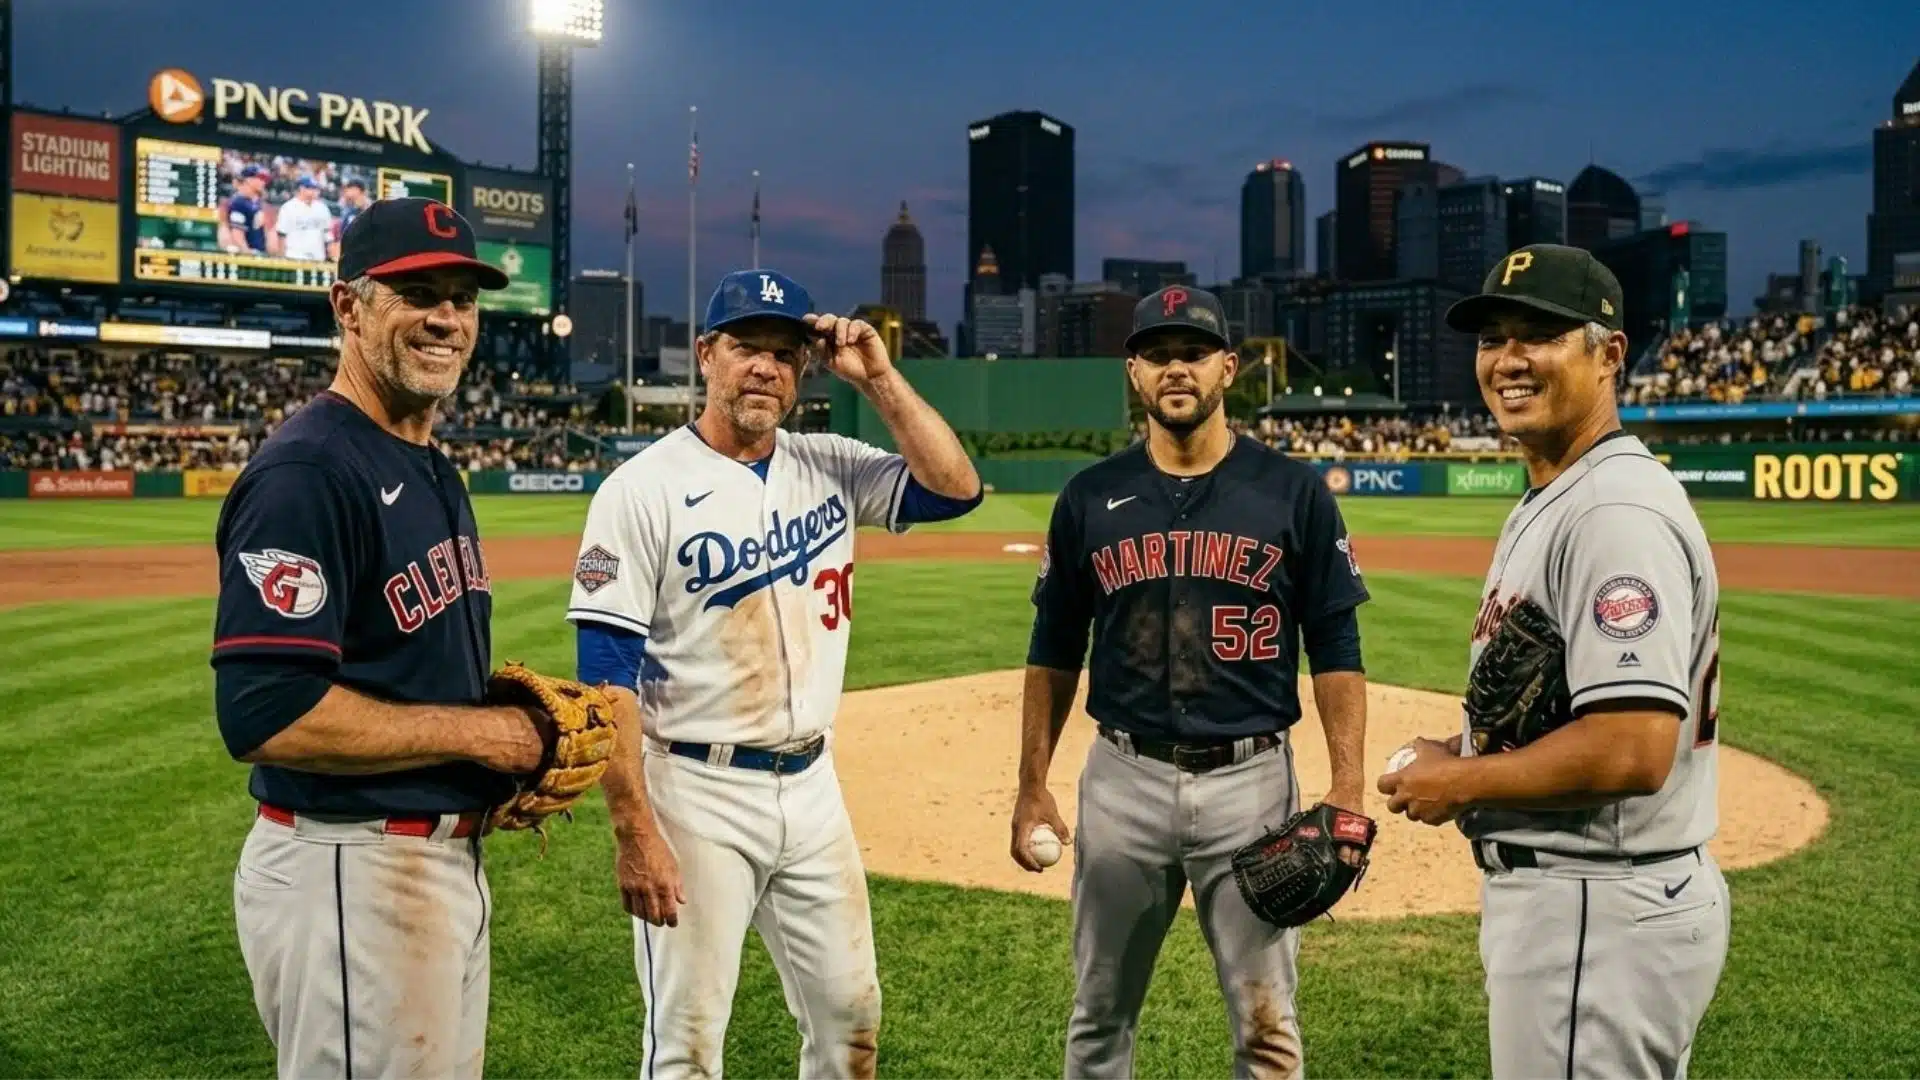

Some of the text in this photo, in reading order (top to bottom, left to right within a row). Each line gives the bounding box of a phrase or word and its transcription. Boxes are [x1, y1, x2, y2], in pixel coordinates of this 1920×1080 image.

[212, 78, 309, 125] PNC
[318, 91, 433, 155] PARK
[21, 132, 110, 161] STADIUM
[21, 152, 110, 181] LIGHTING
[473, 186, 545, 215] ROOTS
[424, 202, 458, 239] C
[1501, 251, 1534, 286] P
[759, 274, 784, 305] LA
[1161, 285, 1188, 318] P
[509, 473, 584, 491] GEICO
[1353, 469, 1404, 490] PNC
[1754, 452, 1899, 500] ROOTS
[677, 493, 848, 595] Dodgers
[1091, 531, 1283, 596] MARTINEZ
[1212, 604, 1281, 662] 52
